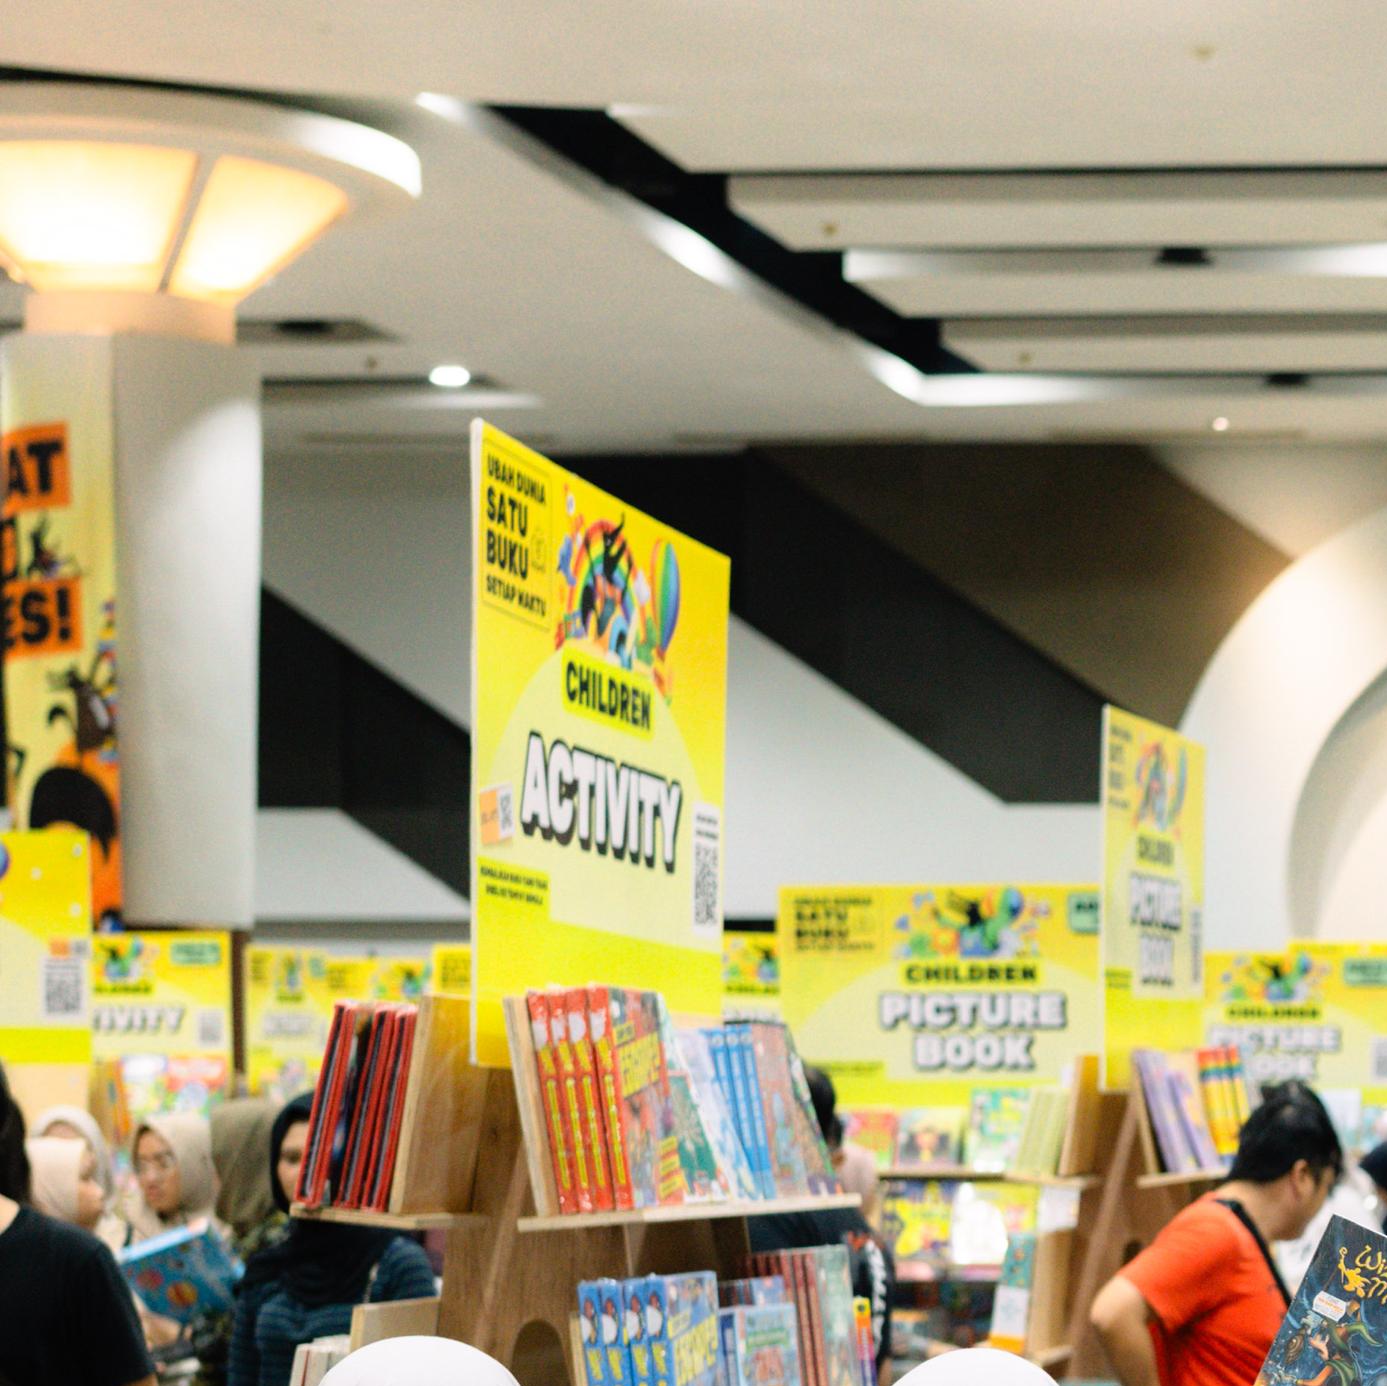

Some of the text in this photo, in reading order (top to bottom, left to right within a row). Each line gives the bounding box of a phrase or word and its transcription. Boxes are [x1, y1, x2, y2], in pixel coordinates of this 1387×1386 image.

[487, 453, 546, 504] UBAH DUNIA
[487, 486, 529, 538] SATU
[487, 529, 529, 580] BUKU
[564, 660, 652, 730] CHILDREN
[520, 731, 682, 874] ACTIVITY
[905, 964, 1038, 984] CHILDREN
[878, 991, 1068, 1031] PICTURE
[913, 1032, 1036, 1070] BOOK
